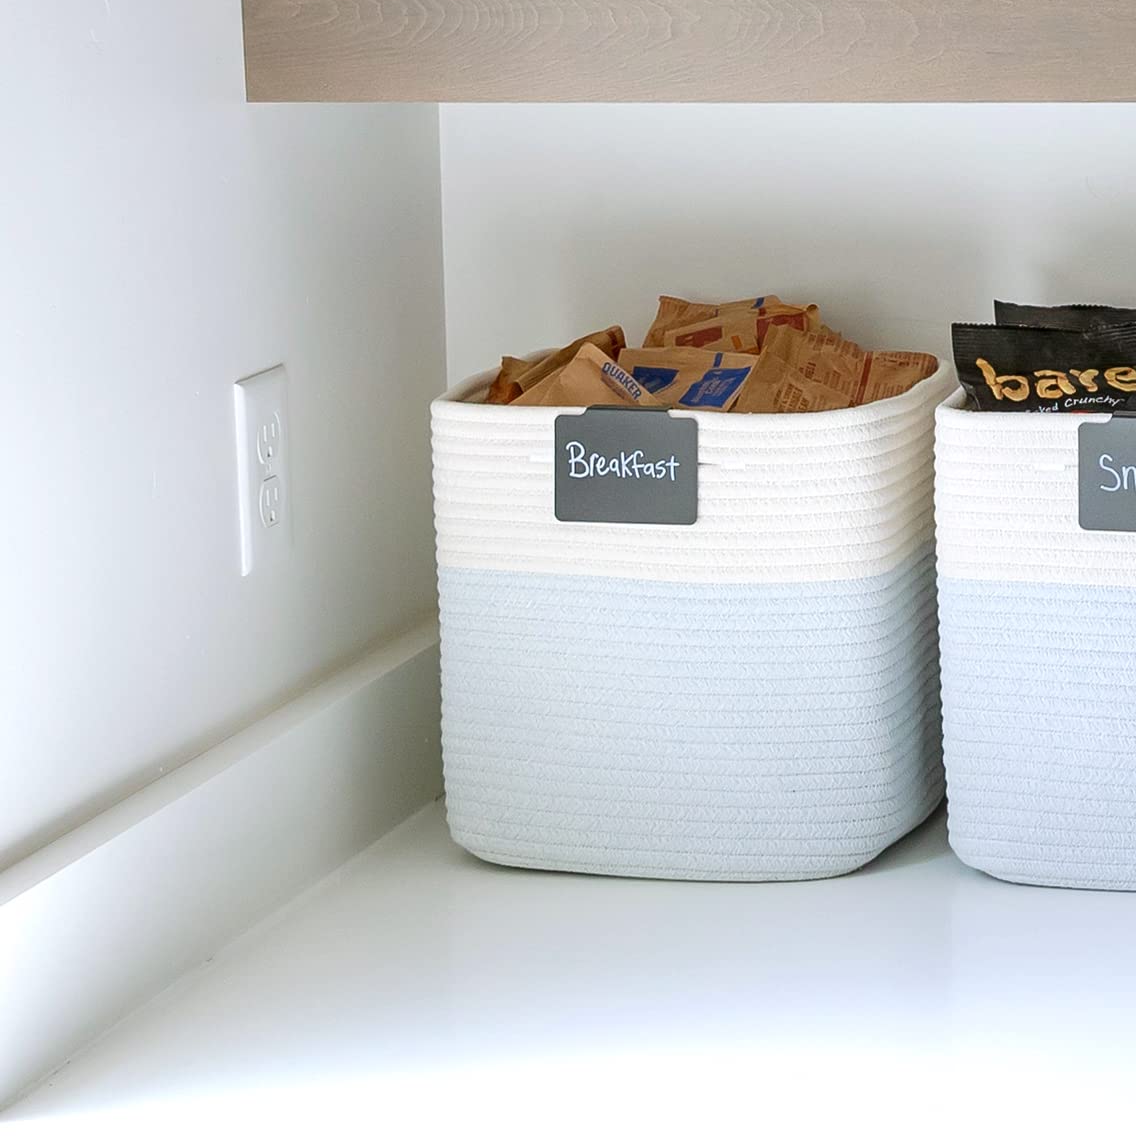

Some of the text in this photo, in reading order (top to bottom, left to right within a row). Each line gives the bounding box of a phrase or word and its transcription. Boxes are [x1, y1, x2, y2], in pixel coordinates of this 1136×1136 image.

[601, 362, 642, 400] QUAKER
[1064, 394, 1125, 408] Crunchy
[565, 441, 680, 481] Breakfast
